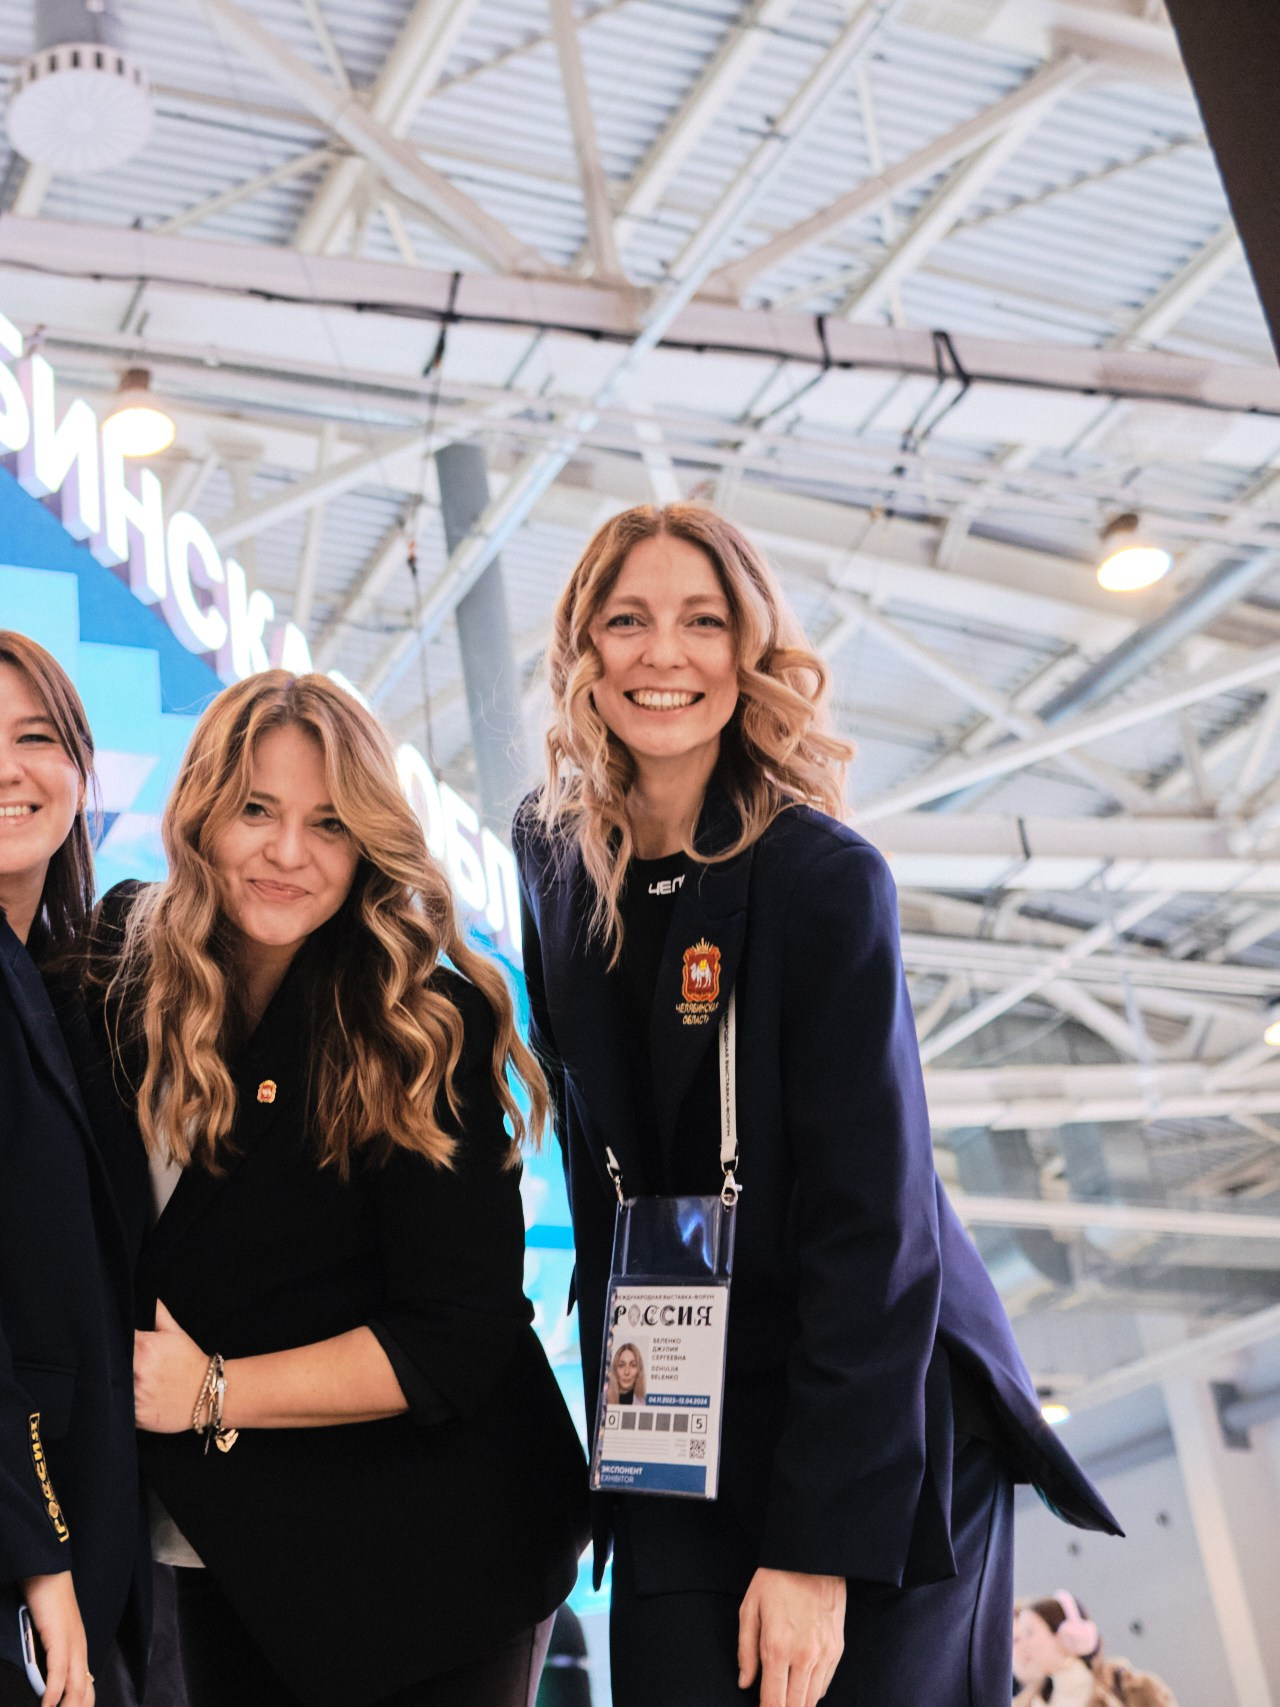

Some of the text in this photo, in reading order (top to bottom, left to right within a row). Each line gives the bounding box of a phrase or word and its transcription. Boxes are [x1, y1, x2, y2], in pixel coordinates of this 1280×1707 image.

[613, 1304, 713, 1328] РОССИЯ
[695, 1418, 703, 1429] 5
[601, 1465, 644, 1475] ЭКСПОНЕНТ
[600, 1475, 634, 1484] EXHIBITOR
